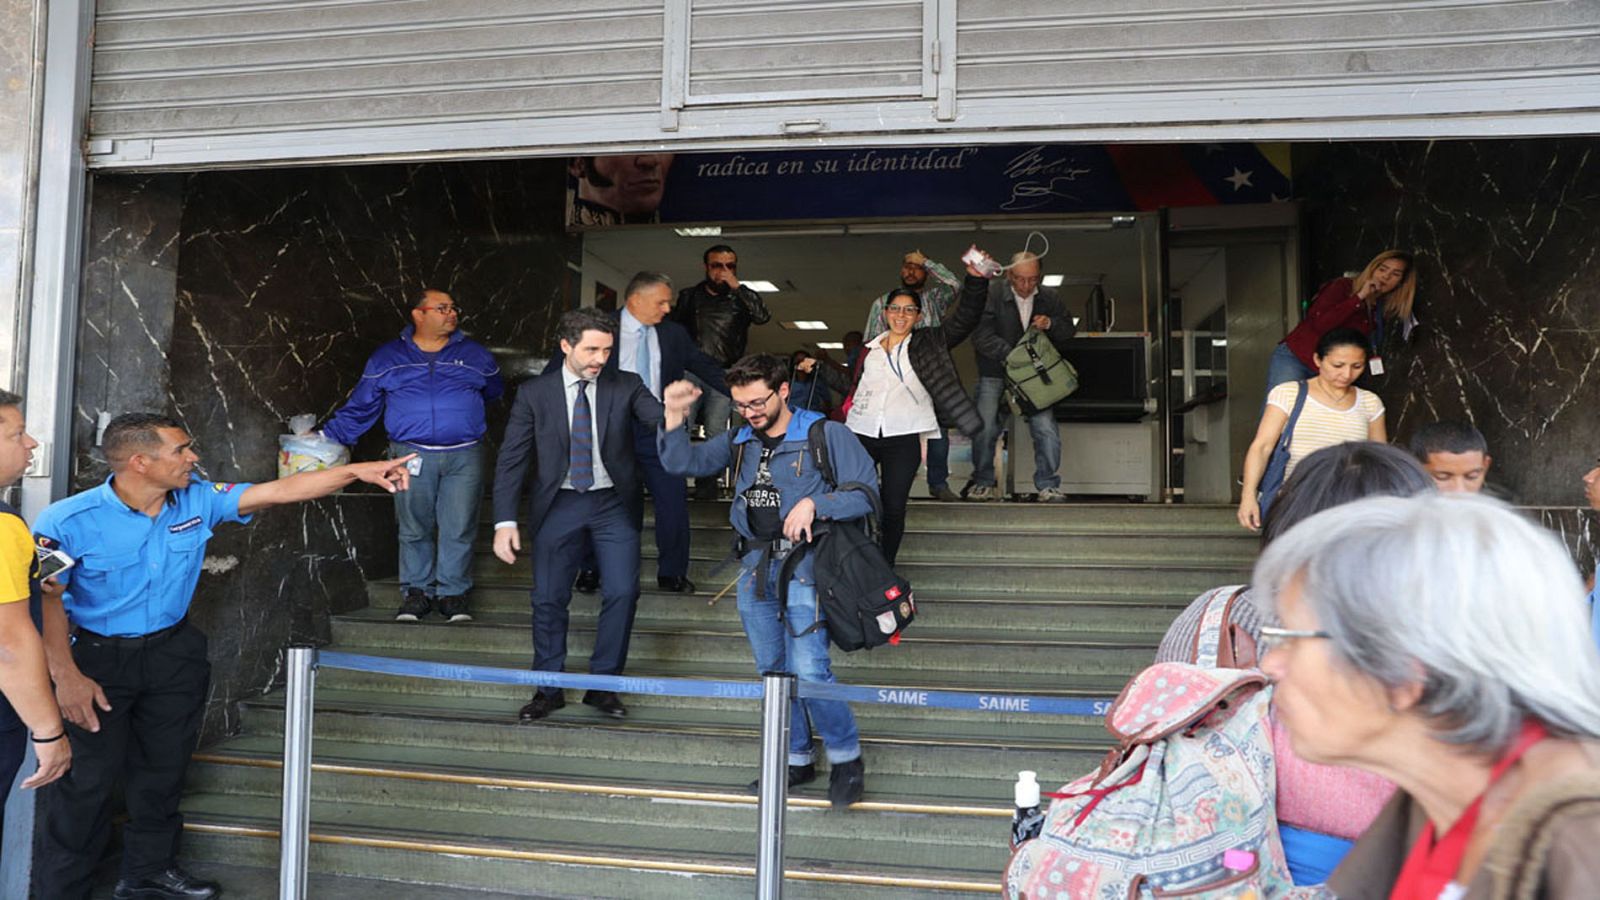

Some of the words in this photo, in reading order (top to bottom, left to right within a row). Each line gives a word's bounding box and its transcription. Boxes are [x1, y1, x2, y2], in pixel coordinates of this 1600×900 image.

[698, 155, 769, 177] radica
[777, 159, 804, 175] en
[812, 158, 839, 173] su
[713, 682, 761, 697] SAIME
[878, 689, 928, 706] SAIME
[979, 696, 1030, 712] SAIME
